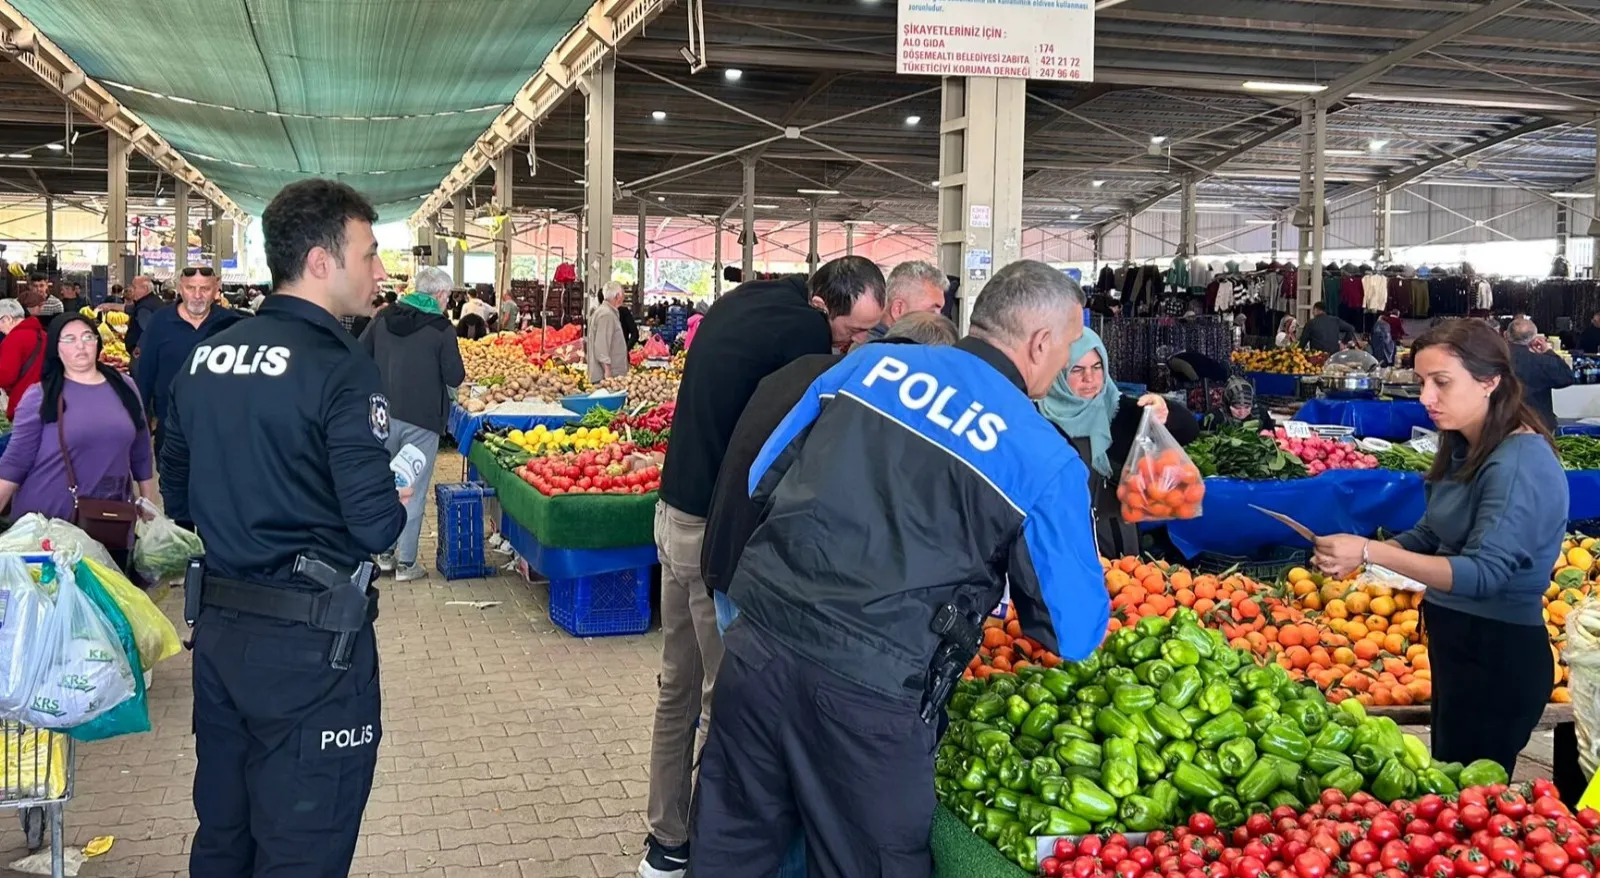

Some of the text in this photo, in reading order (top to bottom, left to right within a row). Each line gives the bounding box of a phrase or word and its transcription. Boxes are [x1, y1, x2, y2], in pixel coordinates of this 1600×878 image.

[903, 22, 980, 37] ŞİKAYETLERİNİZ
[982, 25, 1001, 40] İÇİN
[903, 38, 920, 47] ALO
[923, 39, 945, 48] GIDA
[1039, 44, 1054, 53] 174
[903, 49, 954, 61] DÖŞEMEALTI
[956, 51, 1000, 63] BELEDİYESİ
[1001, 54, 1030, 64] ZABITA
[1040, 56, 1055, 66] 421
[1058, 57, 1067, 66] 21
[1070, 57, 1080, 67] 72
[903, 61, 951, 73] TÜKETİCİYİ
[953, 64, 992, 74] KORUMA
[1057, 68, 1067, 78] 96
[1069, 69, 1080, 79] 46
[33, 696, 59, 711] KRS
